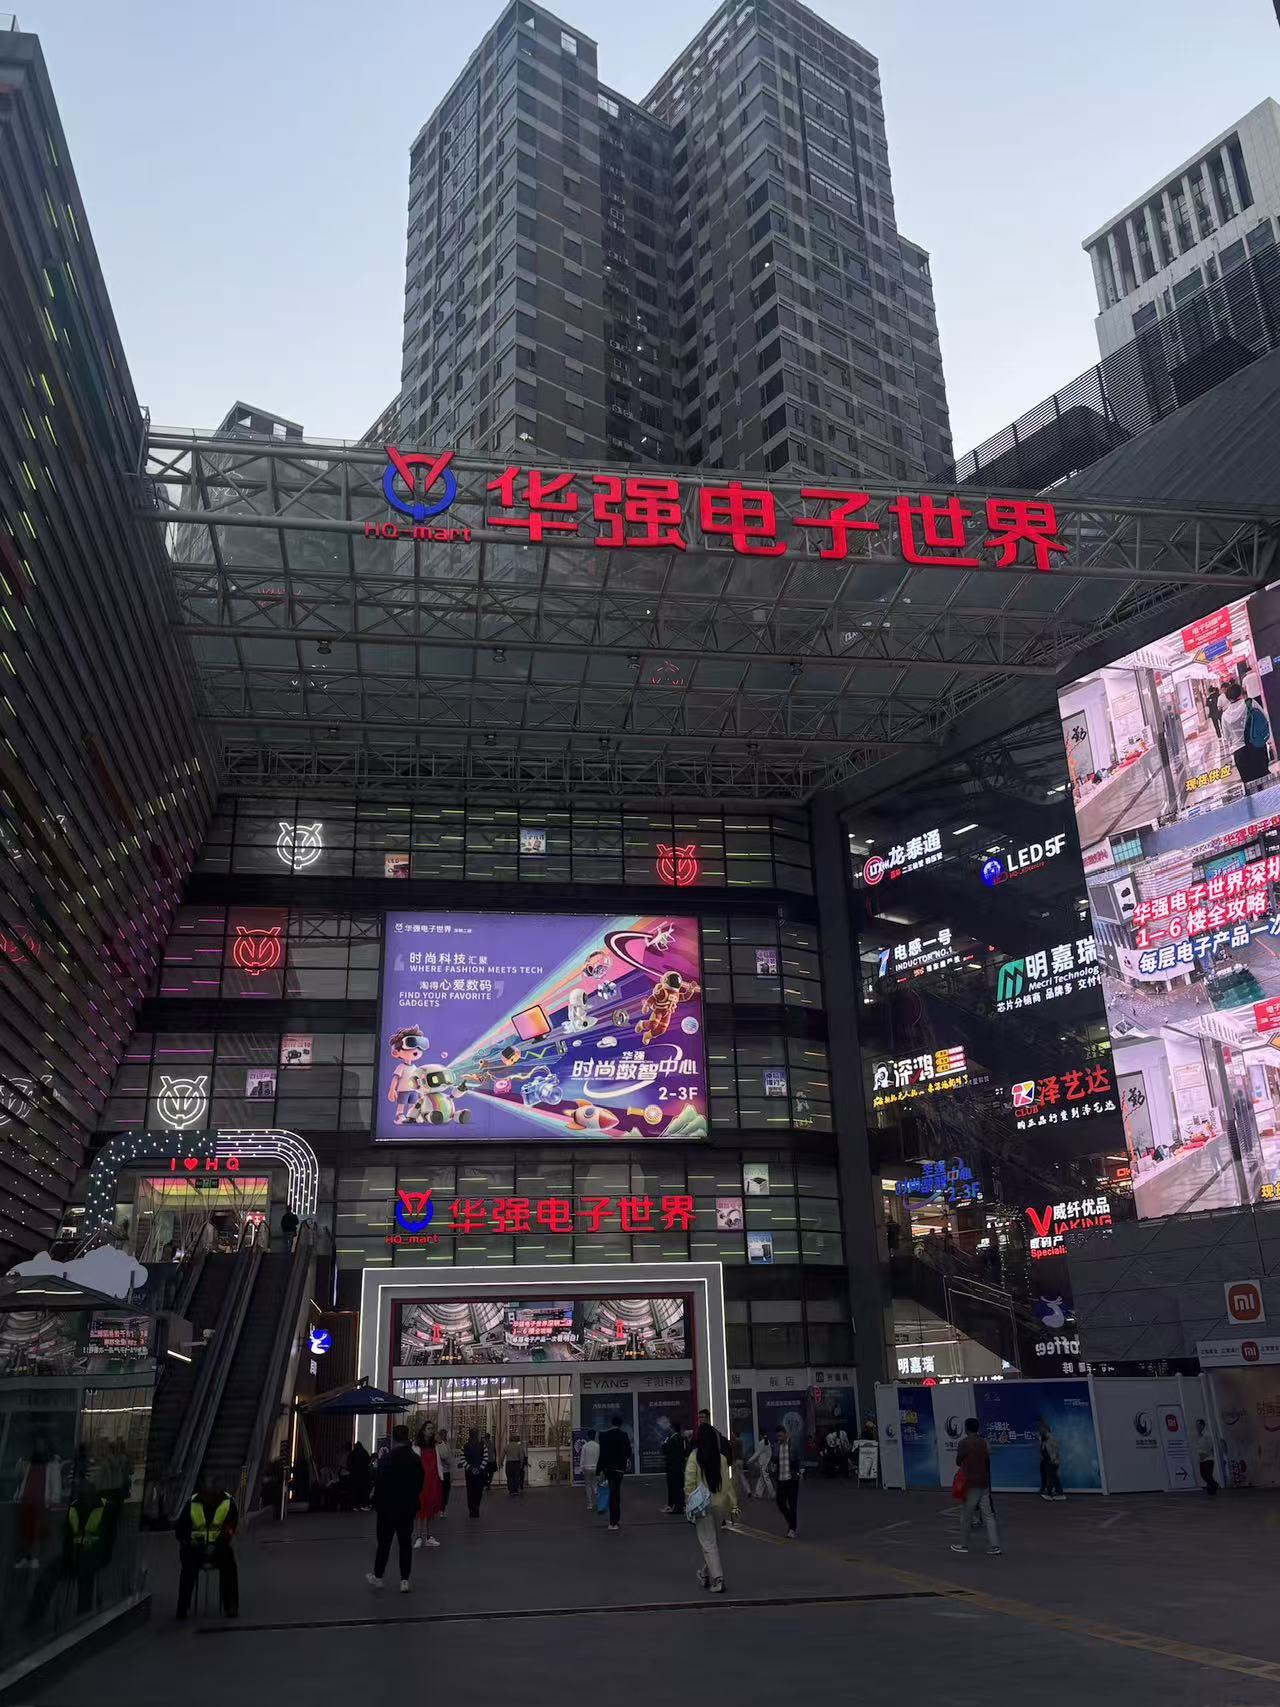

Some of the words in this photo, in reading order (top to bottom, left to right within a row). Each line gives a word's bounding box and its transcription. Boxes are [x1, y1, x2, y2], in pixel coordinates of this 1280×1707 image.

[485, 466, 1069, 571] 华强电子世界
[364, 521, 471, 543] HQ-mart
[888, 829, 941, 868] 龙泰通
[404, 925, 452, 934] 华强电子世界
[894, 928, 952, 960] 电感一号
[1025, 935, 1098, 979] 明嘉瑞
[410, 965, 442, 973] WHERE
[488, 966, 517, 974] MEETS
[520, 966, 543, 974] TECH
[1054, 966, 1102, 983] Technolog
[400, 991, 420, 999] FIND
[450, 992, 491, 1000] FAVORITE
[997, 991, 1041, 1012] 芯片分销商
[1046, 983, 1073, 1000] 品牌多
[622, 1051, 646, 1060] 华强
[571, 1056, 699, 1080] 时尚数智中心
[659, 1087, 698, 1100] 2-3F
[1037, 1063, 1111, 1106] 泽艺达
[1015, 1105, 1038, 1118] CLUB
[171, 1157, 176, 1171] I
[448, 1195, 696, 1233] 华强电子世界
[1053, 1197, 1111, 1220] 威纤优品
[898, 1355, 935, 1374] 明嘉瑞
[583, 1378, 629, 1389] EYANG
